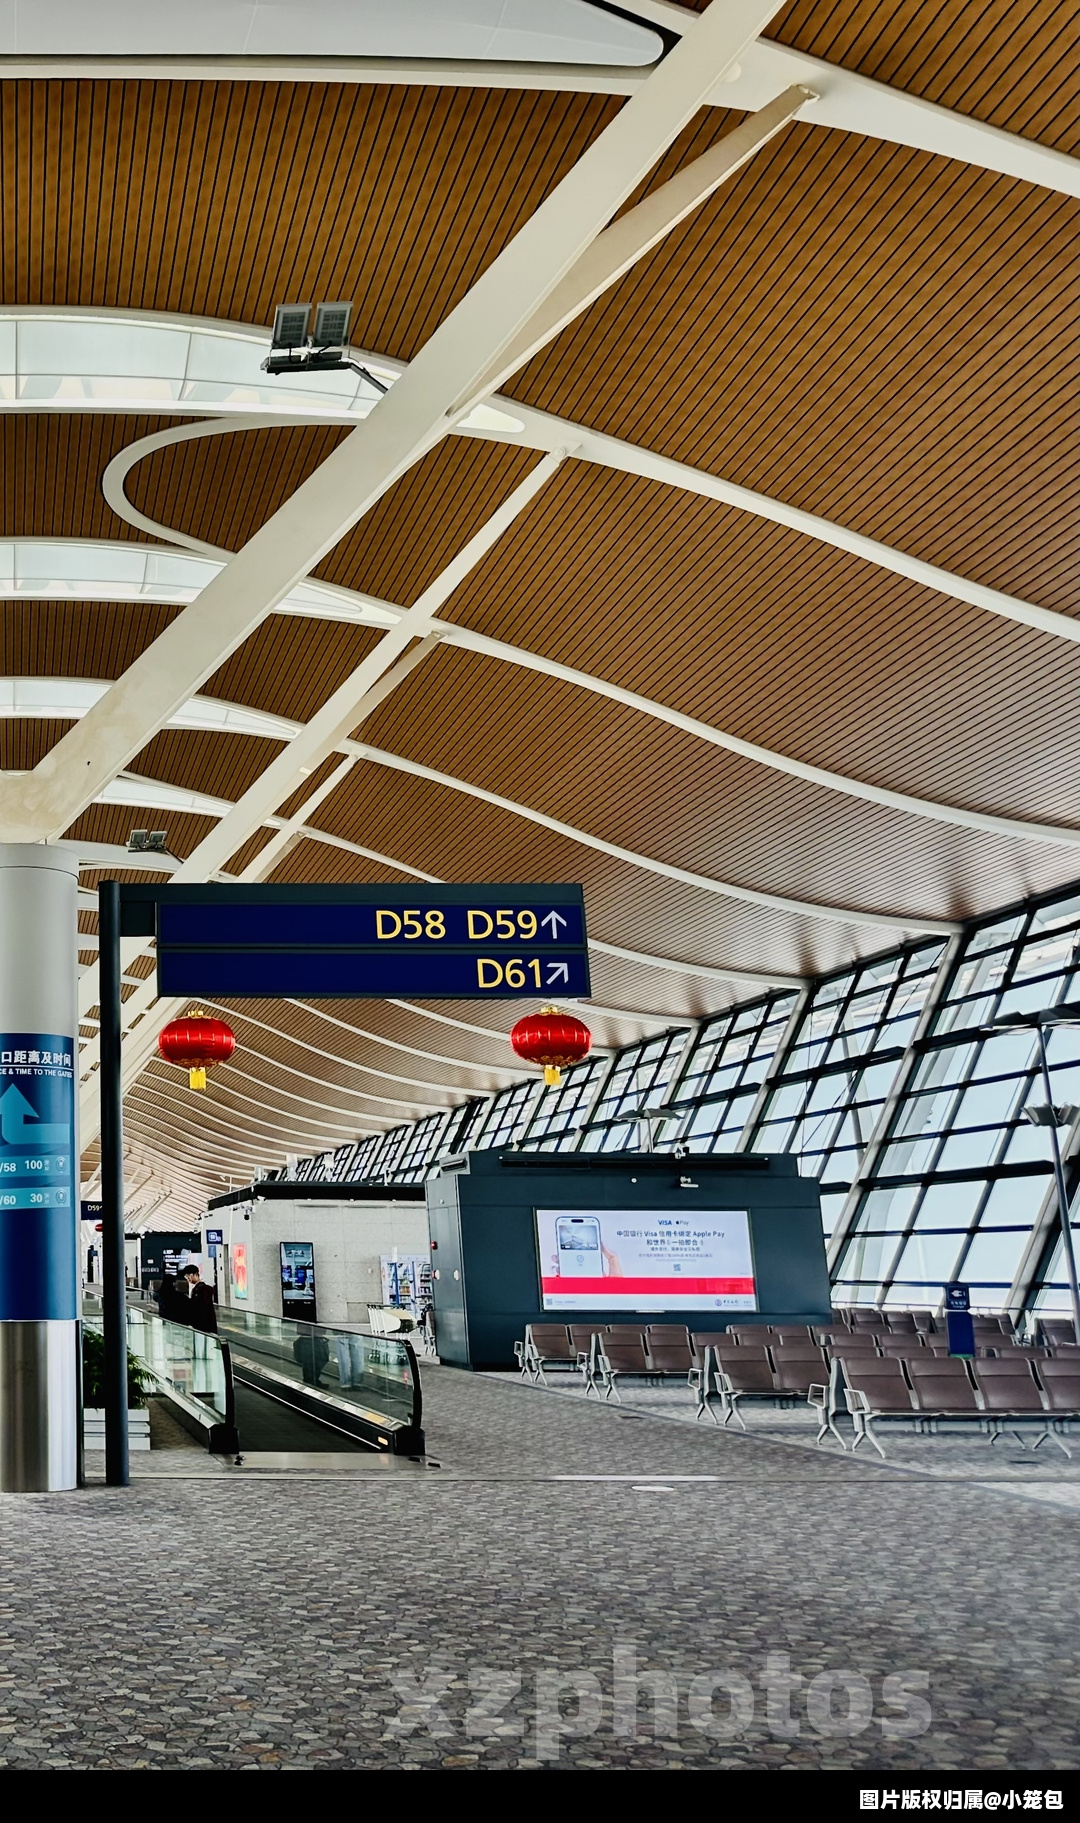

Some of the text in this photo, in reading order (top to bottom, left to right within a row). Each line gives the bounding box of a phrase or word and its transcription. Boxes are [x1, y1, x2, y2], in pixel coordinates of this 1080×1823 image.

[376, 910, 537, 939] D58 D59
[477, 959, 541, 988] D61
[57, 1070, 73, 1078] GATES
[25, 1160, 43, 1170] 100
[30, 1193, 43, 1203] 30
[713, 1230, 725, 1238] Pay
